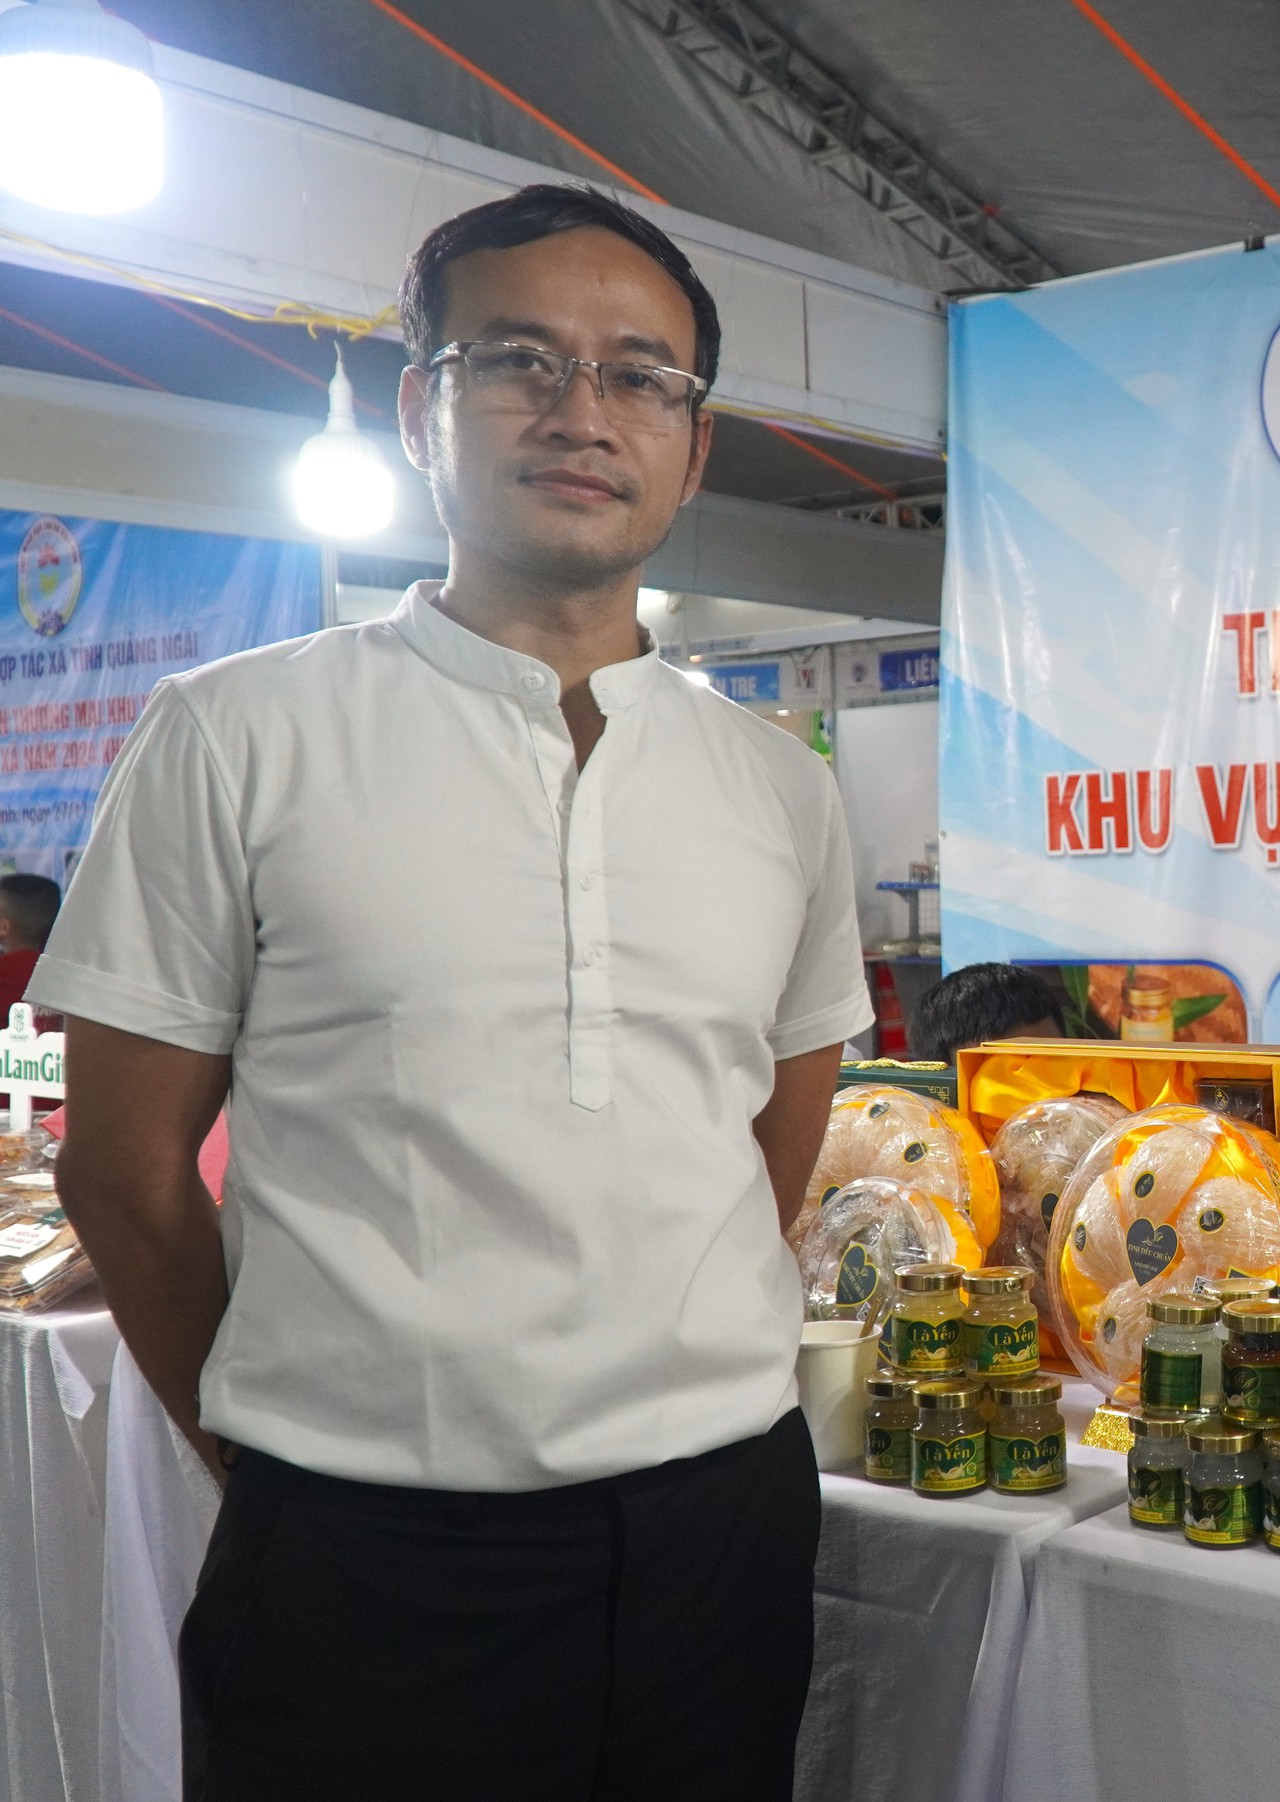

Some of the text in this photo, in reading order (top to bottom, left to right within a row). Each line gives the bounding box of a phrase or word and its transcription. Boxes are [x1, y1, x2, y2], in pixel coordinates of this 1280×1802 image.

[0, 655, 17, 686] ỢP
[20, 652, 45, 679] TÁC
[49, 645, 67, 675] XÃ
[107, 632, 157, 670] QUẢNG
[1046, 768, 1173, 852] KHU
[1013, 1326, 1034, 1343] Yến
[944, 1442, 970, 1460] Yến
